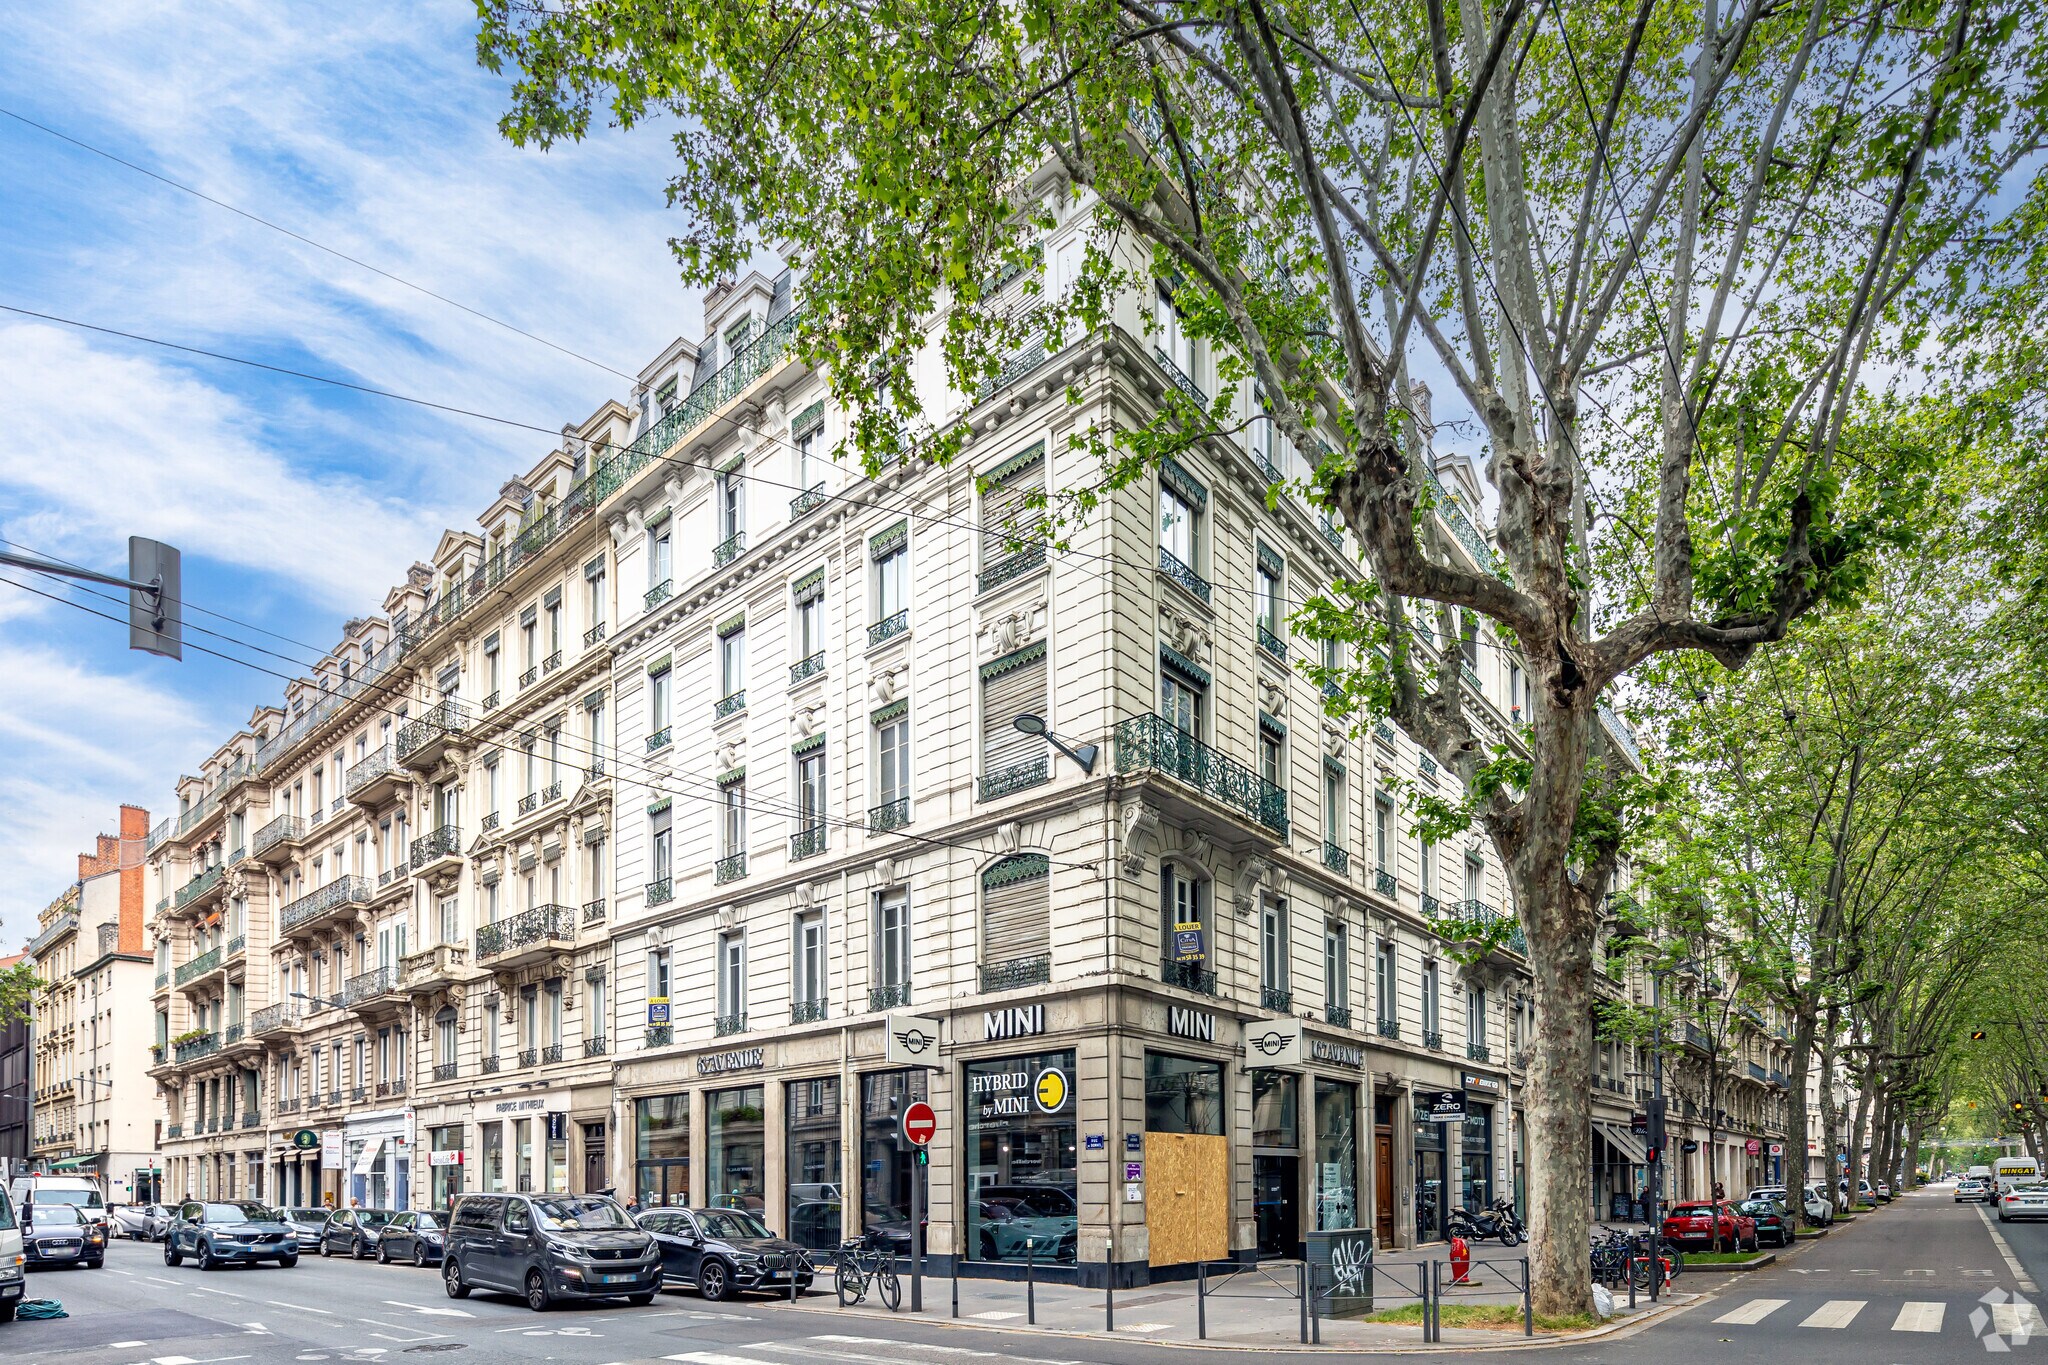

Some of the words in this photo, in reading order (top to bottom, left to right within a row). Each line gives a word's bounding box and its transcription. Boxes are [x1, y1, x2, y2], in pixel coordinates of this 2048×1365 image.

[1178, 923, 1200, 931] LOUER
[984, 1004, 1045, 1041] MINI
[1169, 1005, 1216, 1042] MINI
[908, 1038, 922, 1046] MINI
[1264, 1040, 1279, 1048] MINI
[972, 1072, 1028, 1093] HYBRID
[496, 1101, 517, 1113] FABRICE
[982, 1104, 993, 1118] by
[993, 1096, 1030, 1115] MINI
[1433, 1102, 1461, 1111] ZERO
